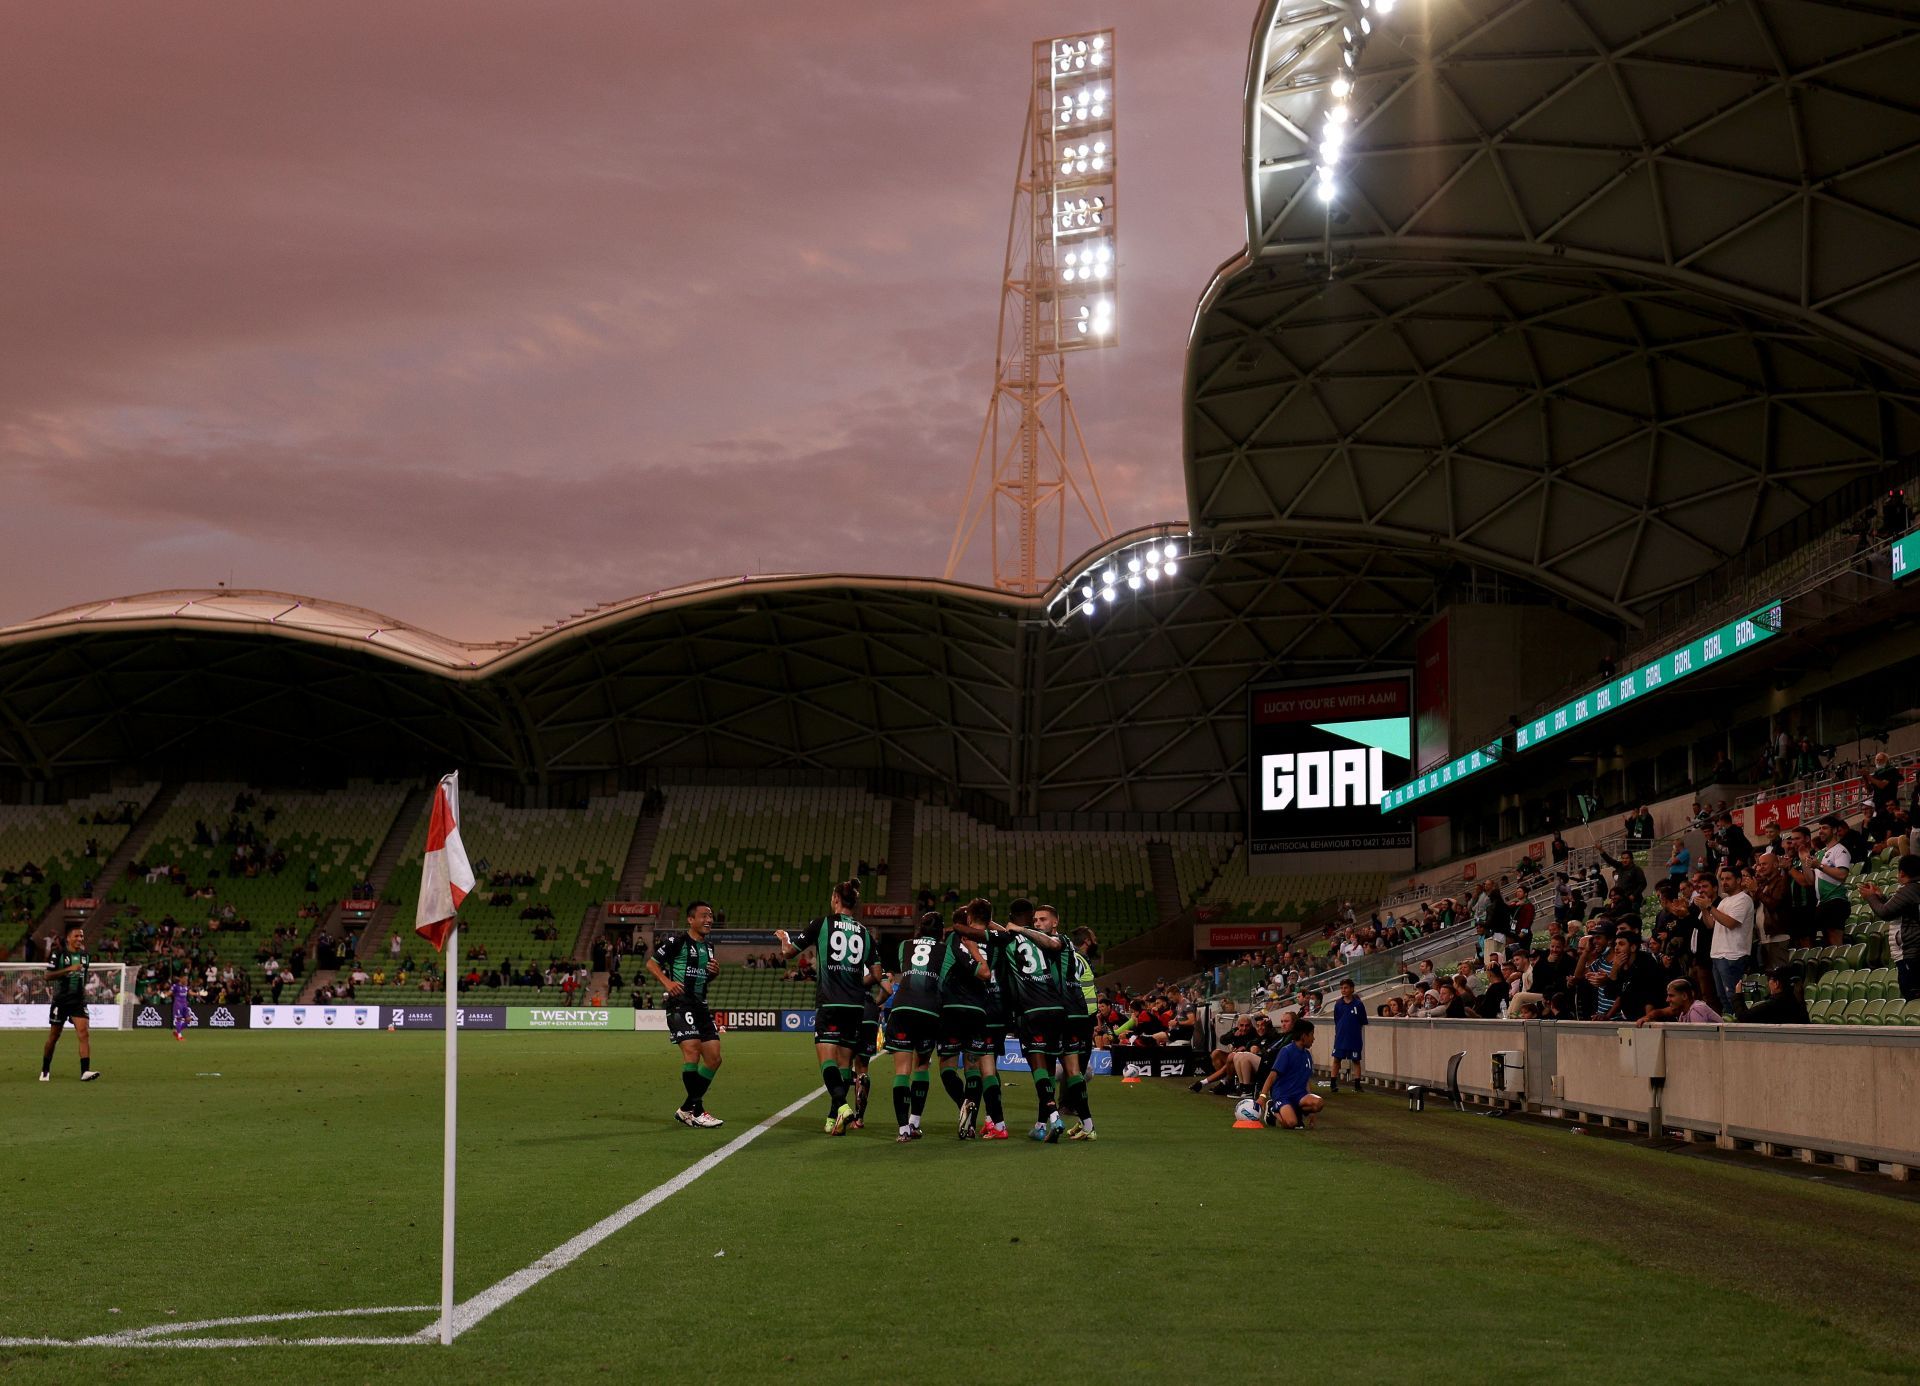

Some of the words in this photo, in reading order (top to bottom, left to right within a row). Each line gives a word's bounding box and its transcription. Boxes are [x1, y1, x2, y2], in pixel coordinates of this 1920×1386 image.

[1892, 544, 1907, 575] AL
[1597, 687, 1611, 711] GOAL
[1620, 676, 1635, 701] GOAL
[1645, 663, 1662, 689] GOAL
[1674, 649, 1692, 675] GOAL
[1703, 634, 1722, 662] GOAL
[1735, 619, 1756, 647] GOAL
[1264, 701, 1296, 714] LUCKY
[1297, 697, 1336, 711] YOU'RE
[1339, 693, 1366, 707] WITH
[1367, 690, 1397, 705] AAMI
[1261, 747, 1393, 811] GOAL
[1268, 839, 1309, 851] ANTISOCIAL
[1310, 837, 1350, 849] BEHAVIOUR
[1351, 837, 1362, 848] TO
[830, 930, 865, 965] 99
[912, 938, 937, 946] WALES
[911, 945, 933, 967] 8
[1017, 942, 1047, 974] 31
[530, 1010, 609, 1021] TWENTY3
[684, 1011, 695, 1026] 6
[1160, 1063, 1185, 1078] 24
